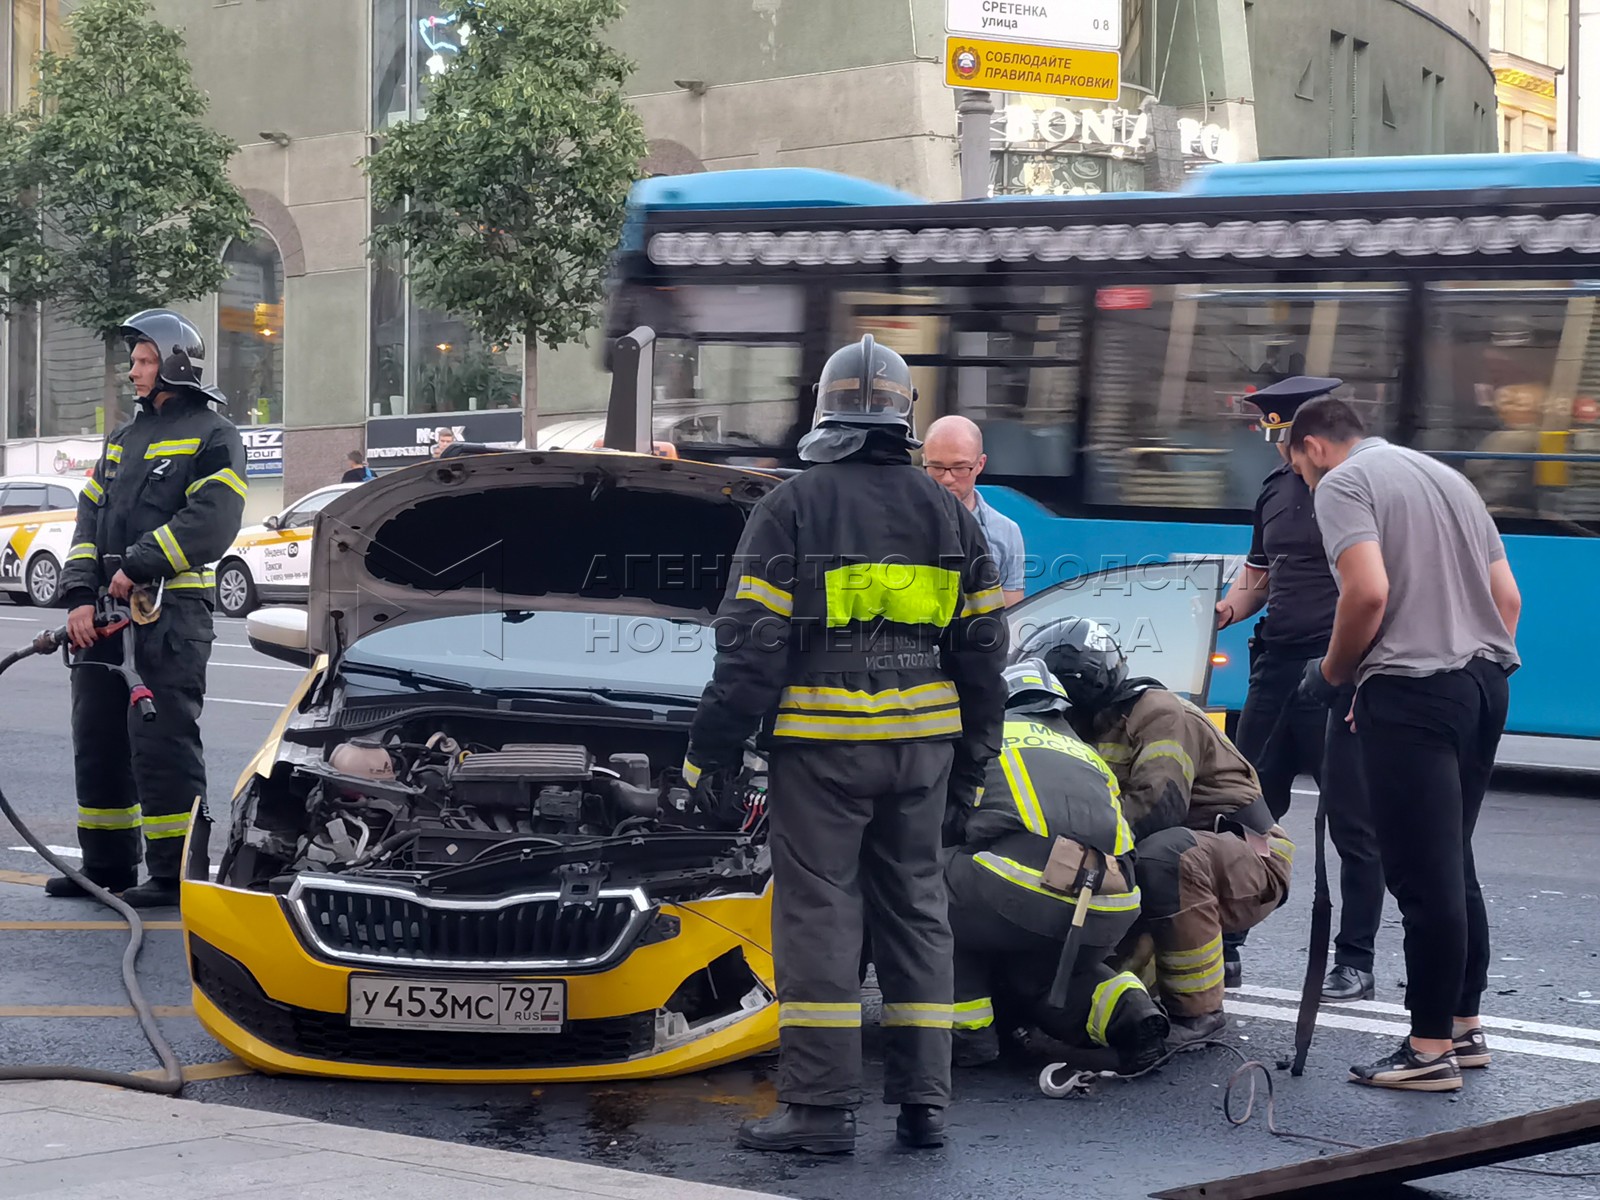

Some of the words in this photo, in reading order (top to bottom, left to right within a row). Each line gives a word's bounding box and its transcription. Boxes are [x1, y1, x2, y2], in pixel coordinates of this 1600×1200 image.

[982, 1, 1047, 18] СРЕТЕНКА
[981, 17, 1018, 29] улица
[985, 51, 1072, 70] СОБЛЮДАЙТЕ
[985, 67, 1042, 83] ПРАВИЛА
[1045, 74, 1113, 89] ПАРКОВКИ!
[878, 361, 887, 377] 2
[153, 458, 171, 475] 2
[264, 561, 283, 571] Такси
[501, 986, 553, 1011] 797
[514, 1011, 540, 1021] RUS
